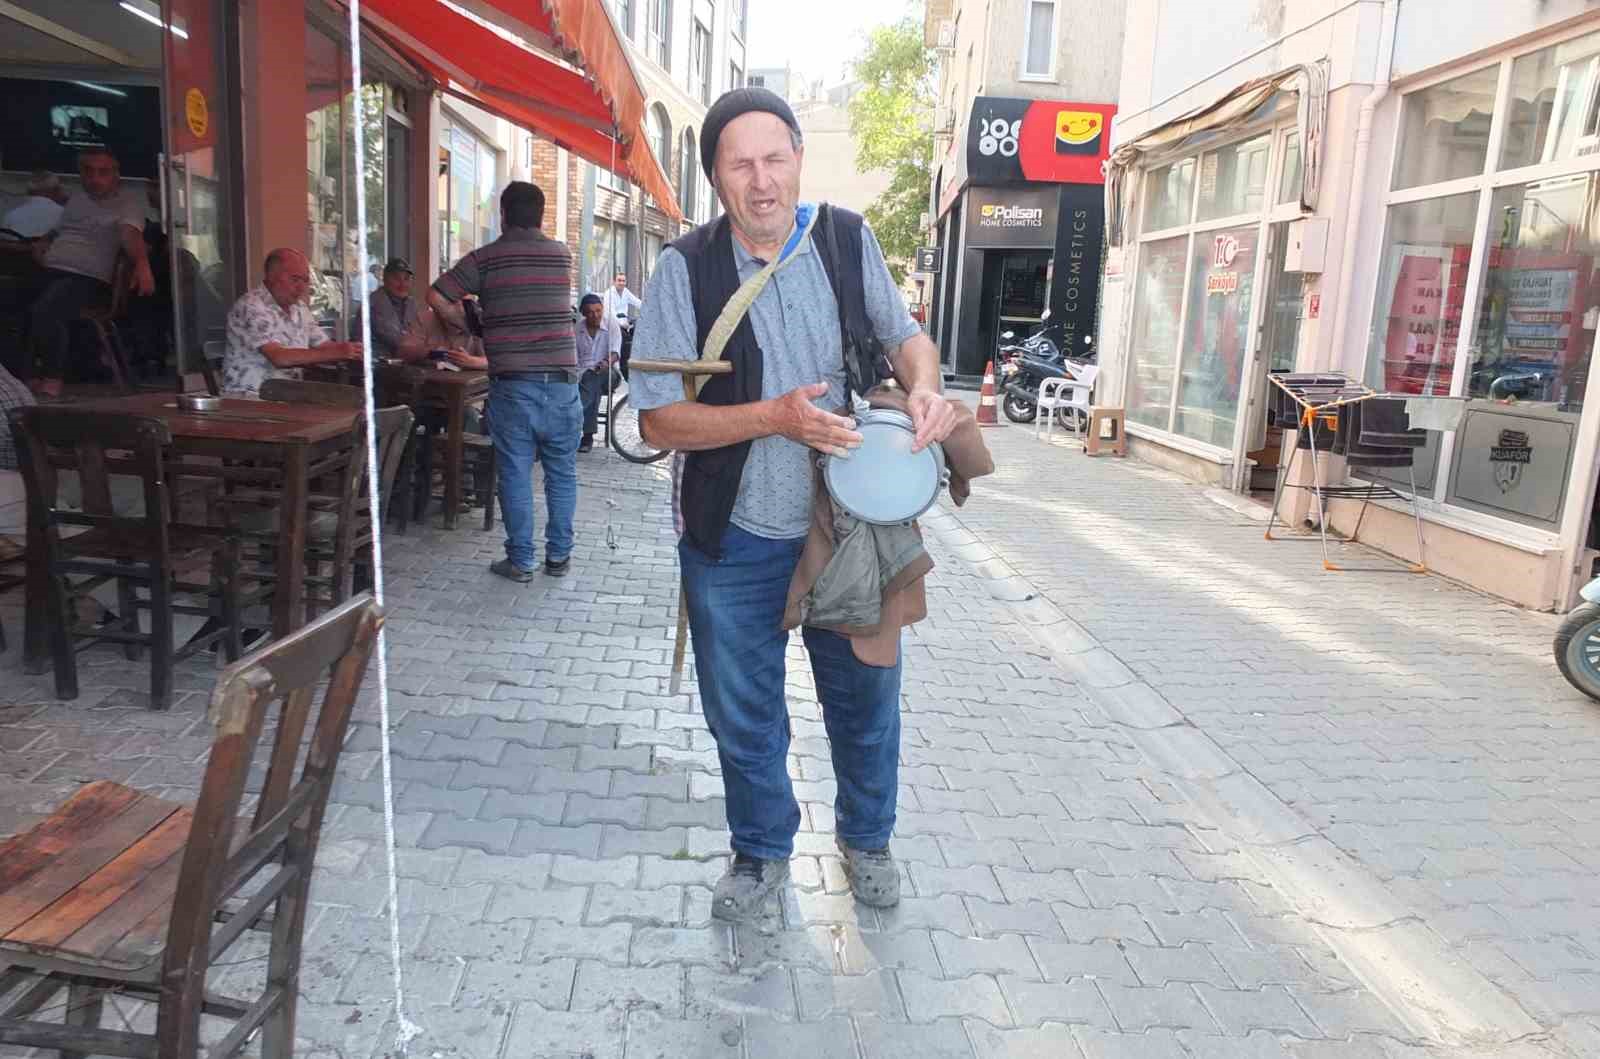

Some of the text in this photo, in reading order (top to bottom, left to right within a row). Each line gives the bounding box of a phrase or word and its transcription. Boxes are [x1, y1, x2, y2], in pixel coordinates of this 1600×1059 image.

[994, 205, 1042, 219] Polisan
[980, 218, 1042, 227] HOME COSMETICS
[1061, 209, 1087, 358] OME COSMETICS
